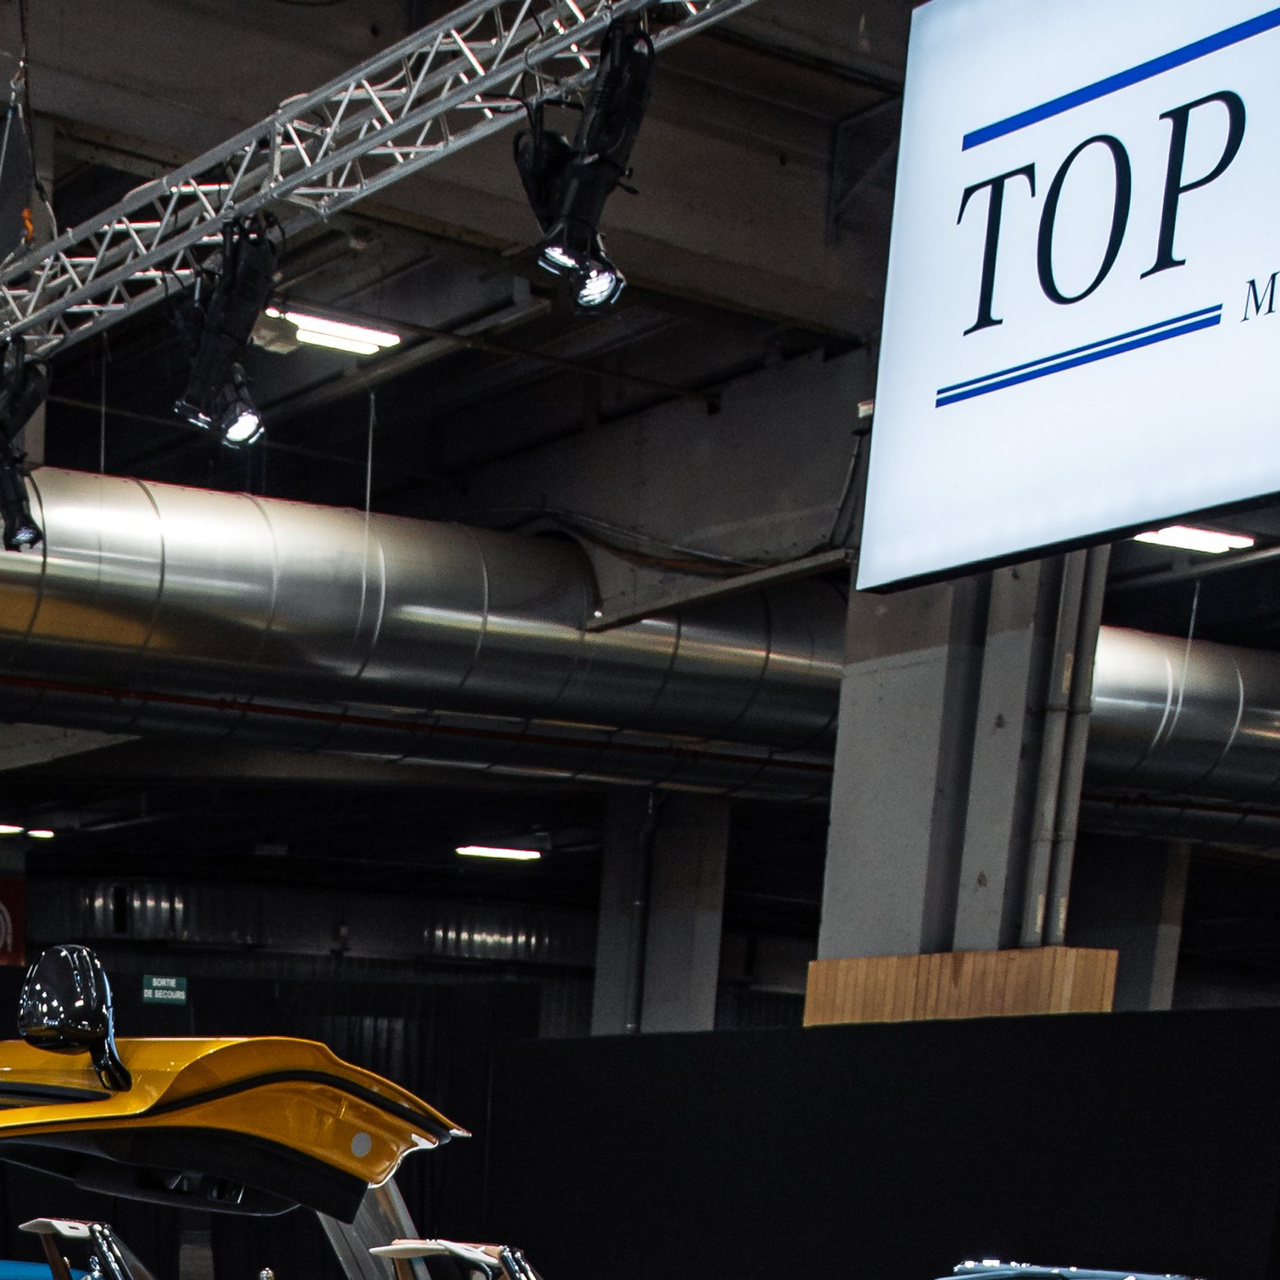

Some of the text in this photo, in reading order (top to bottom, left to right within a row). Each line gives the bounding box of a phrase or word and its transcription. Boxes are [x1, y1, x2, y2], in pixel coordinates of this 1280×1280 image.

[956, 90, 1247, 337] TOP
[152, 977, 176, 988] SORTIE
[143, 989, 186, 1000] DE SECOURS
